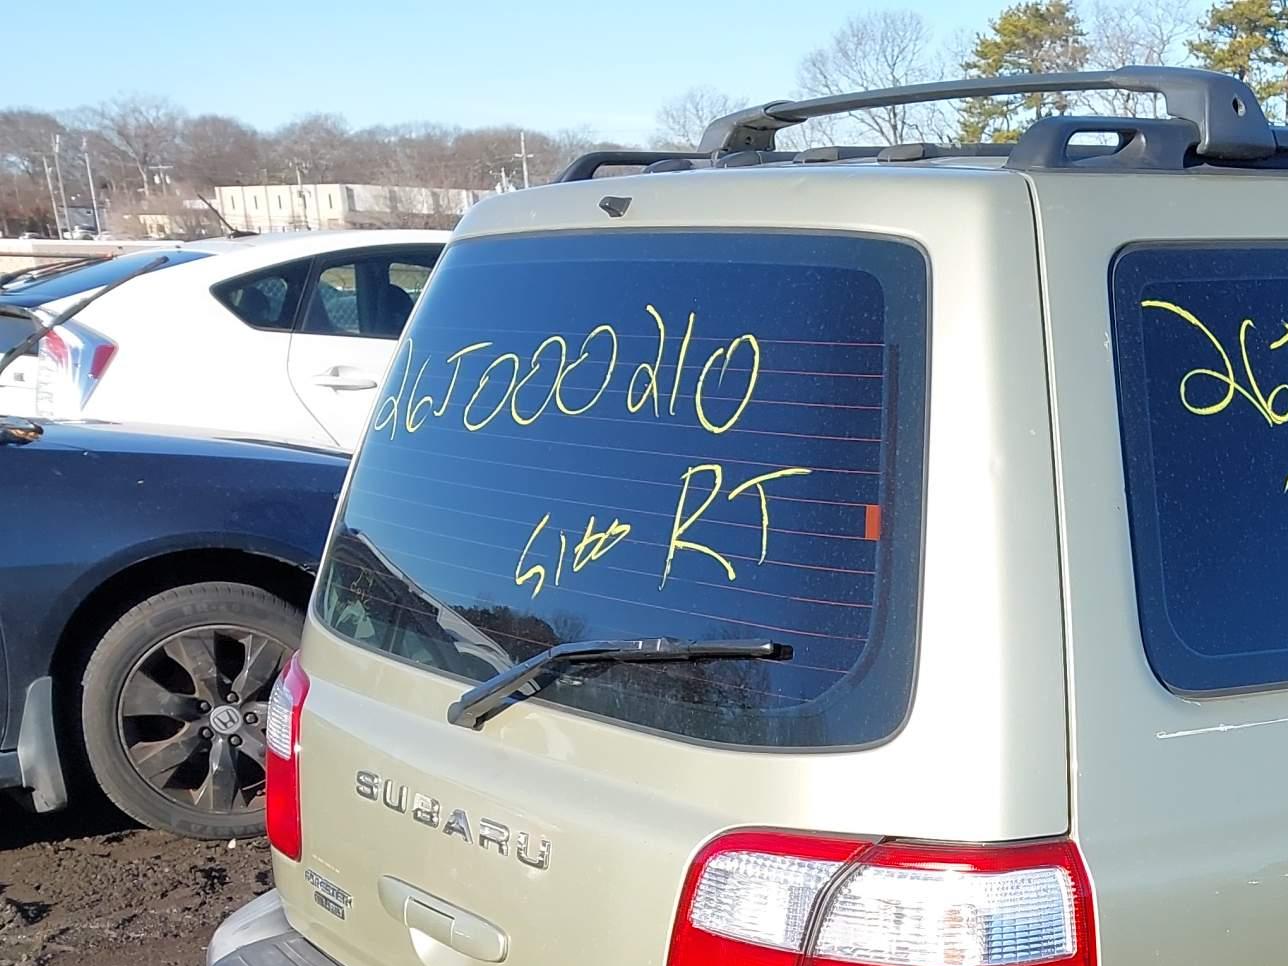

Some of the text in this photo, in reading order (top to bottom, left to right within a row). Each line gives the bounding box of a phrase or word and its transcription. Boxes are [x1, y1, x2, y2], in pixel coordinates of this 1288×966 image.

[374, 303, 760, 441] 26J000210
[658, 464, 813, 591] RT
[355, 769, 552, 871] SUBARU
